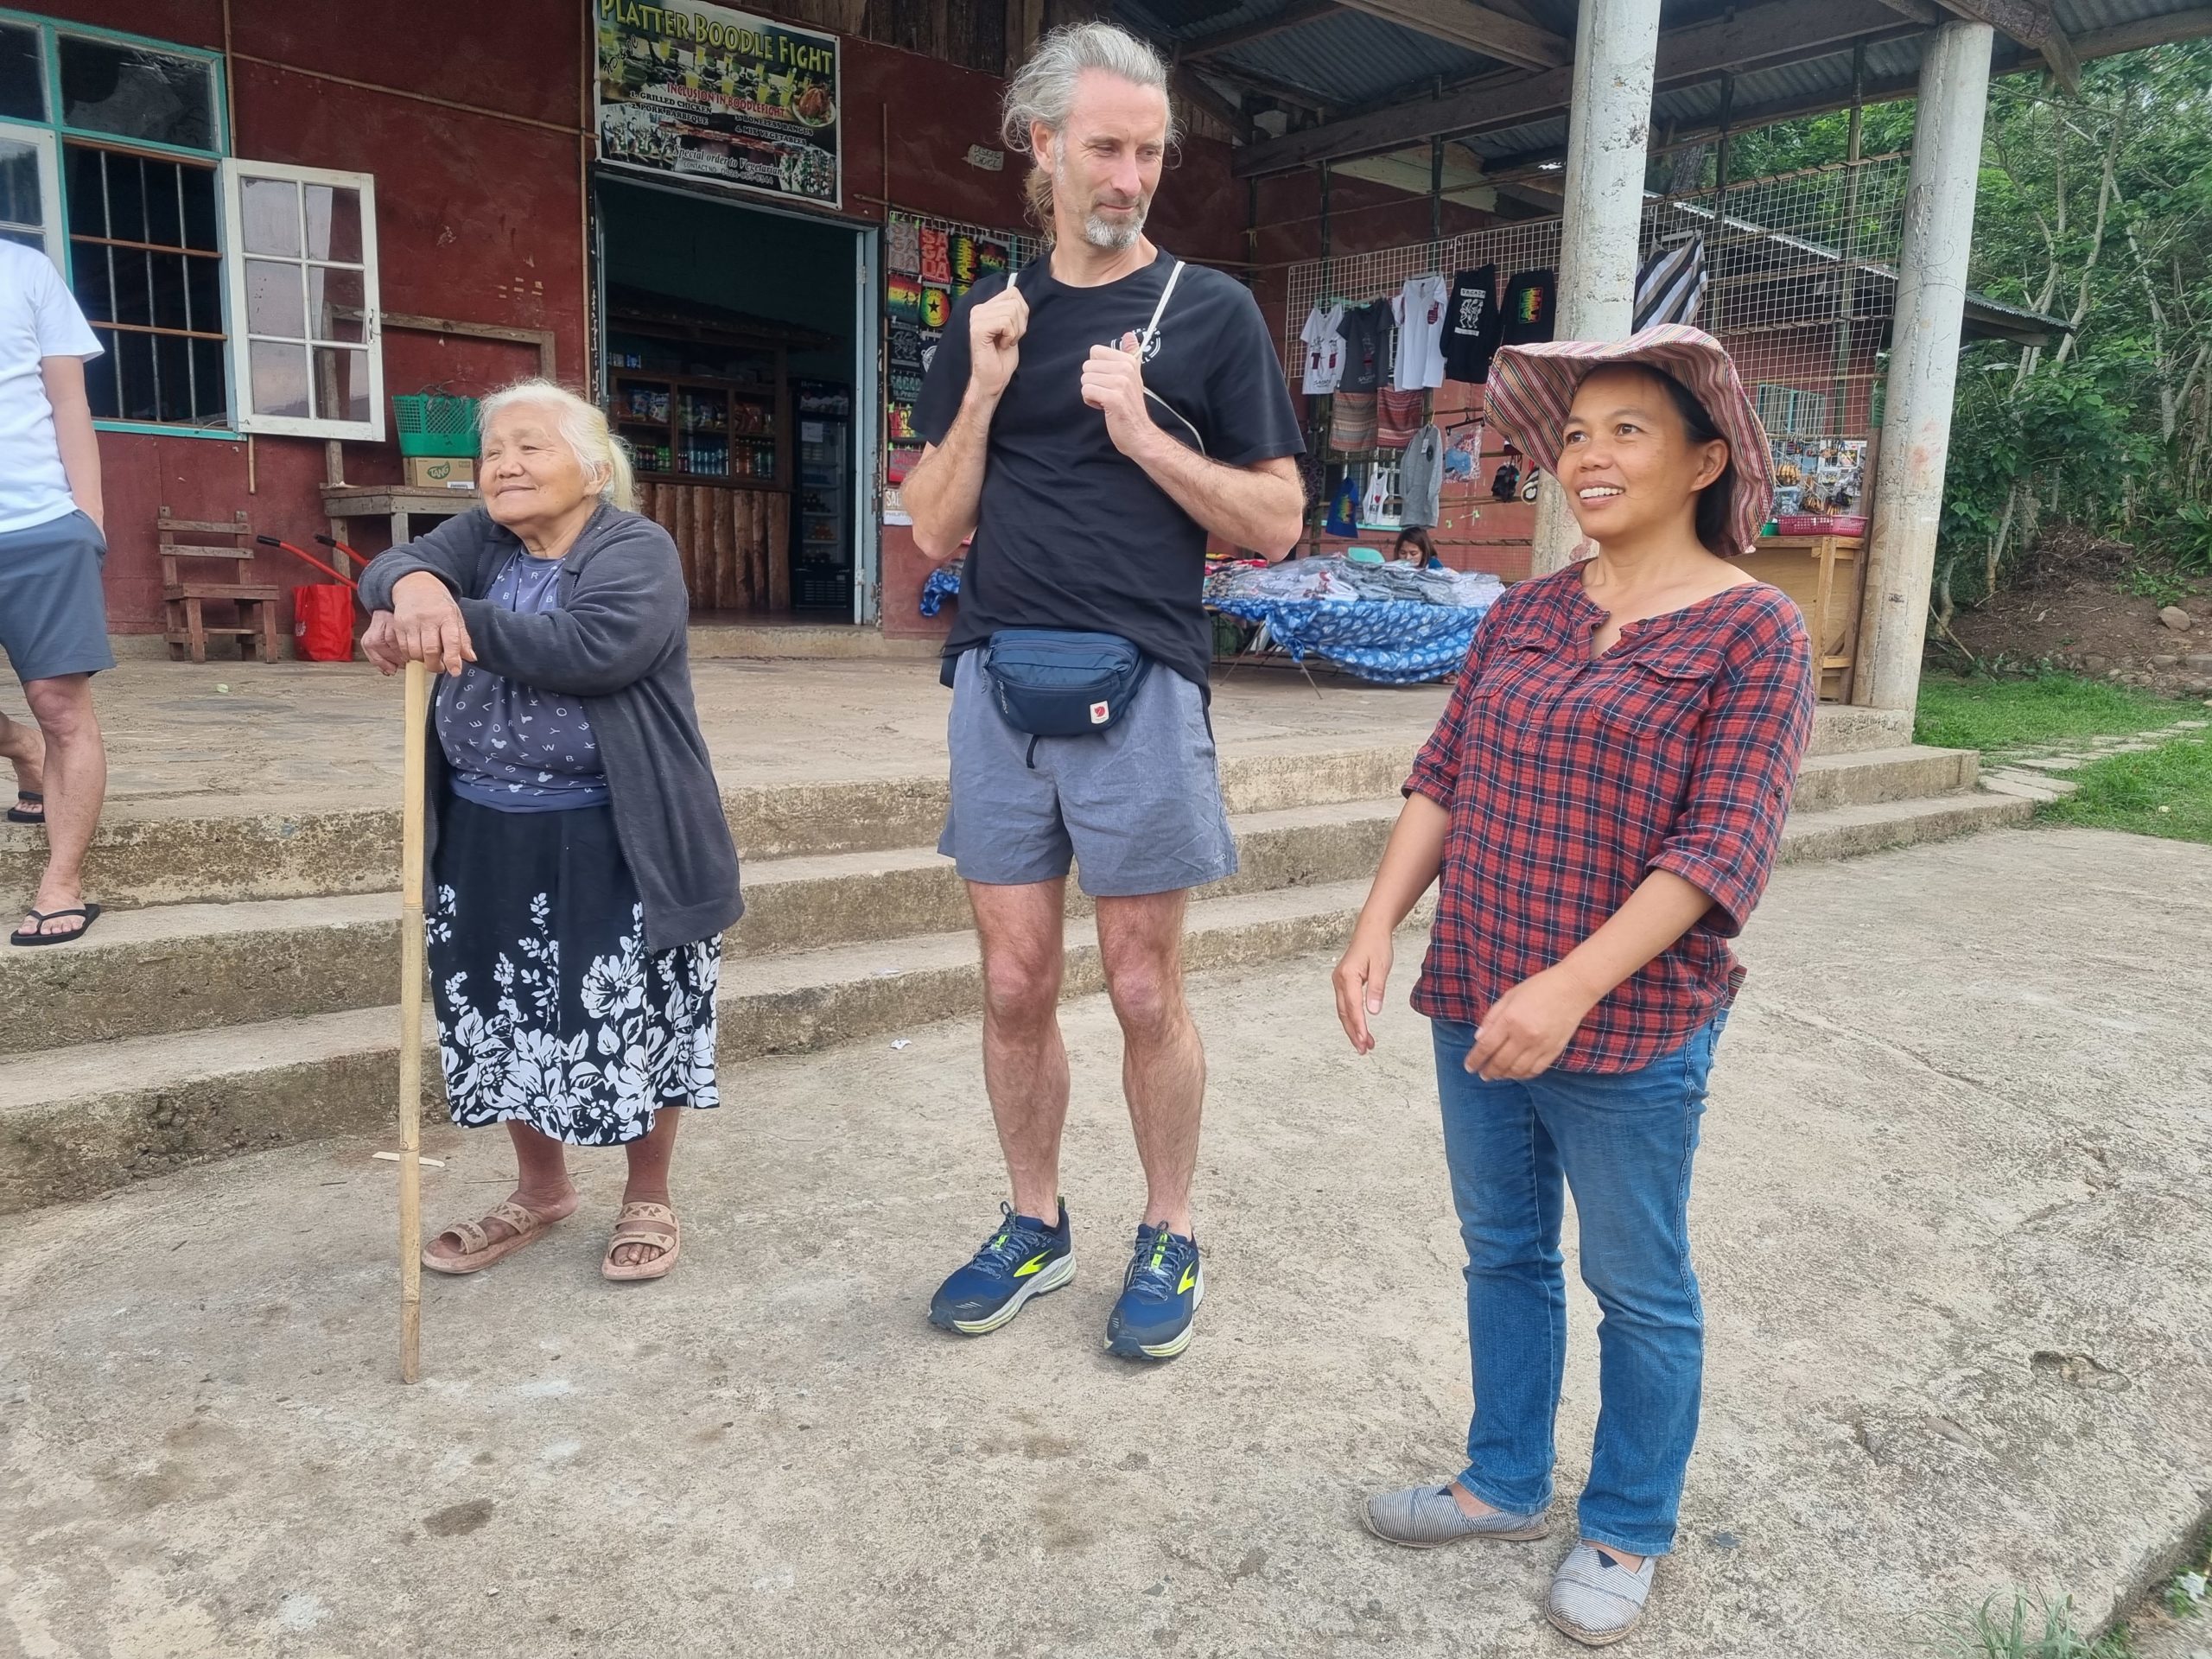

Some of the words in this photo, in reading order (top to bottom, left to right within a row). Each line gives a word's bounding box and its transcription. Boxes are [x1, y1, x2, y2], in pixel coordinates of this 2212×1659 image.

[601, 0, 690, 41] PLATTER
[695, 13, 774, 60] BOODLE
[779, 35, 833, 75] FIGHT
[640, 92, 675, 105] GRILLED
[677, 100, 712, 114] CHICKEN
[667, 82, 715, 102] INCLUSION
[716, 92, 726, 105] IN
[728, 97, 785, 118] BOODLEFIGHT
[640, 104, 664, 114] PORK
[665, 108, 709, 125] BARBEQUE
[743, 116, 782, 130] BONELESS
[743, 126, 759, 137] MIX
[760, 129, 807, 146] VEGETABLES
[673, 144, 704, 160] Special
[706, 153, 728, 165] order
[728, 156, 739, 168] to
[683, 161, 708, 172] CONTACT
[922, 229, 948, 245] SA
[922, 244, 949, 261] GA
[922, 260, 950, 279] DA
[429, 466, 448, 478] TANG
